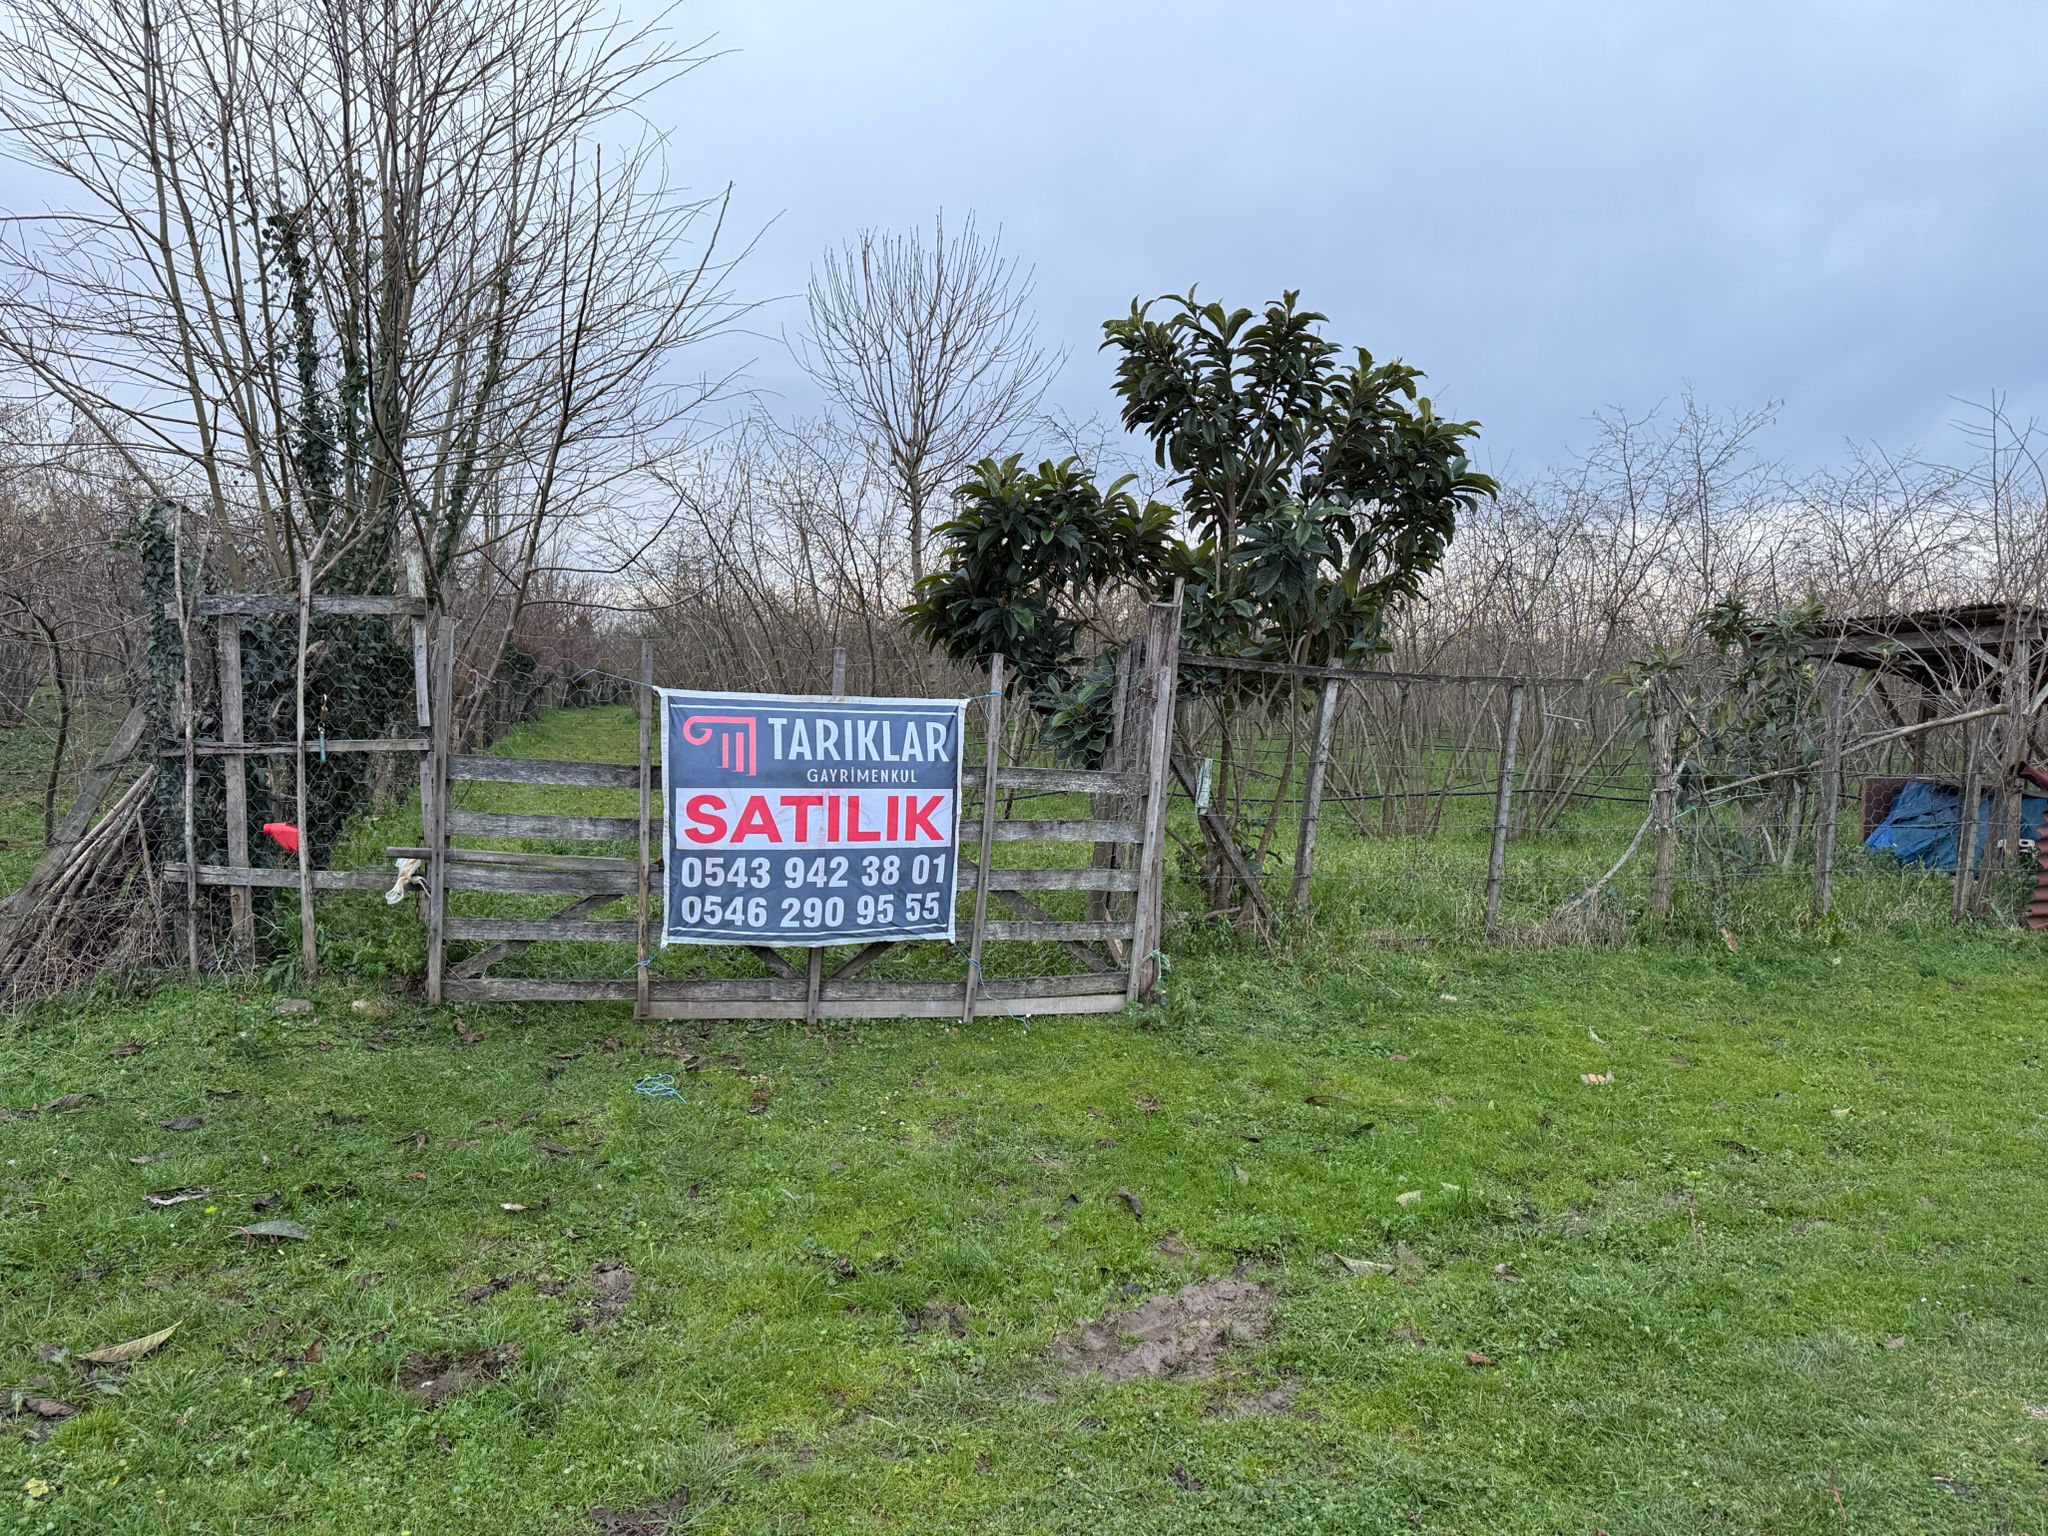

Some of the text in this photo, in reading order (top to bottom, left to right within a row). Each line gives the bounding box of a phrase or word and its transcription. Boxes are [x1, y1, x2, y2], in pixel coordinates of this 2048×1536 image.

[768, 717, 949, 762] TARIKLAR
[807, 766, 917, 783] GAYRİMENKUL
[683, 794, 945, 844] SATILIK
[681, 853, 946, 889] 0543 942 38 01
[681, 892, 940, 928] 0546 290 95 55
